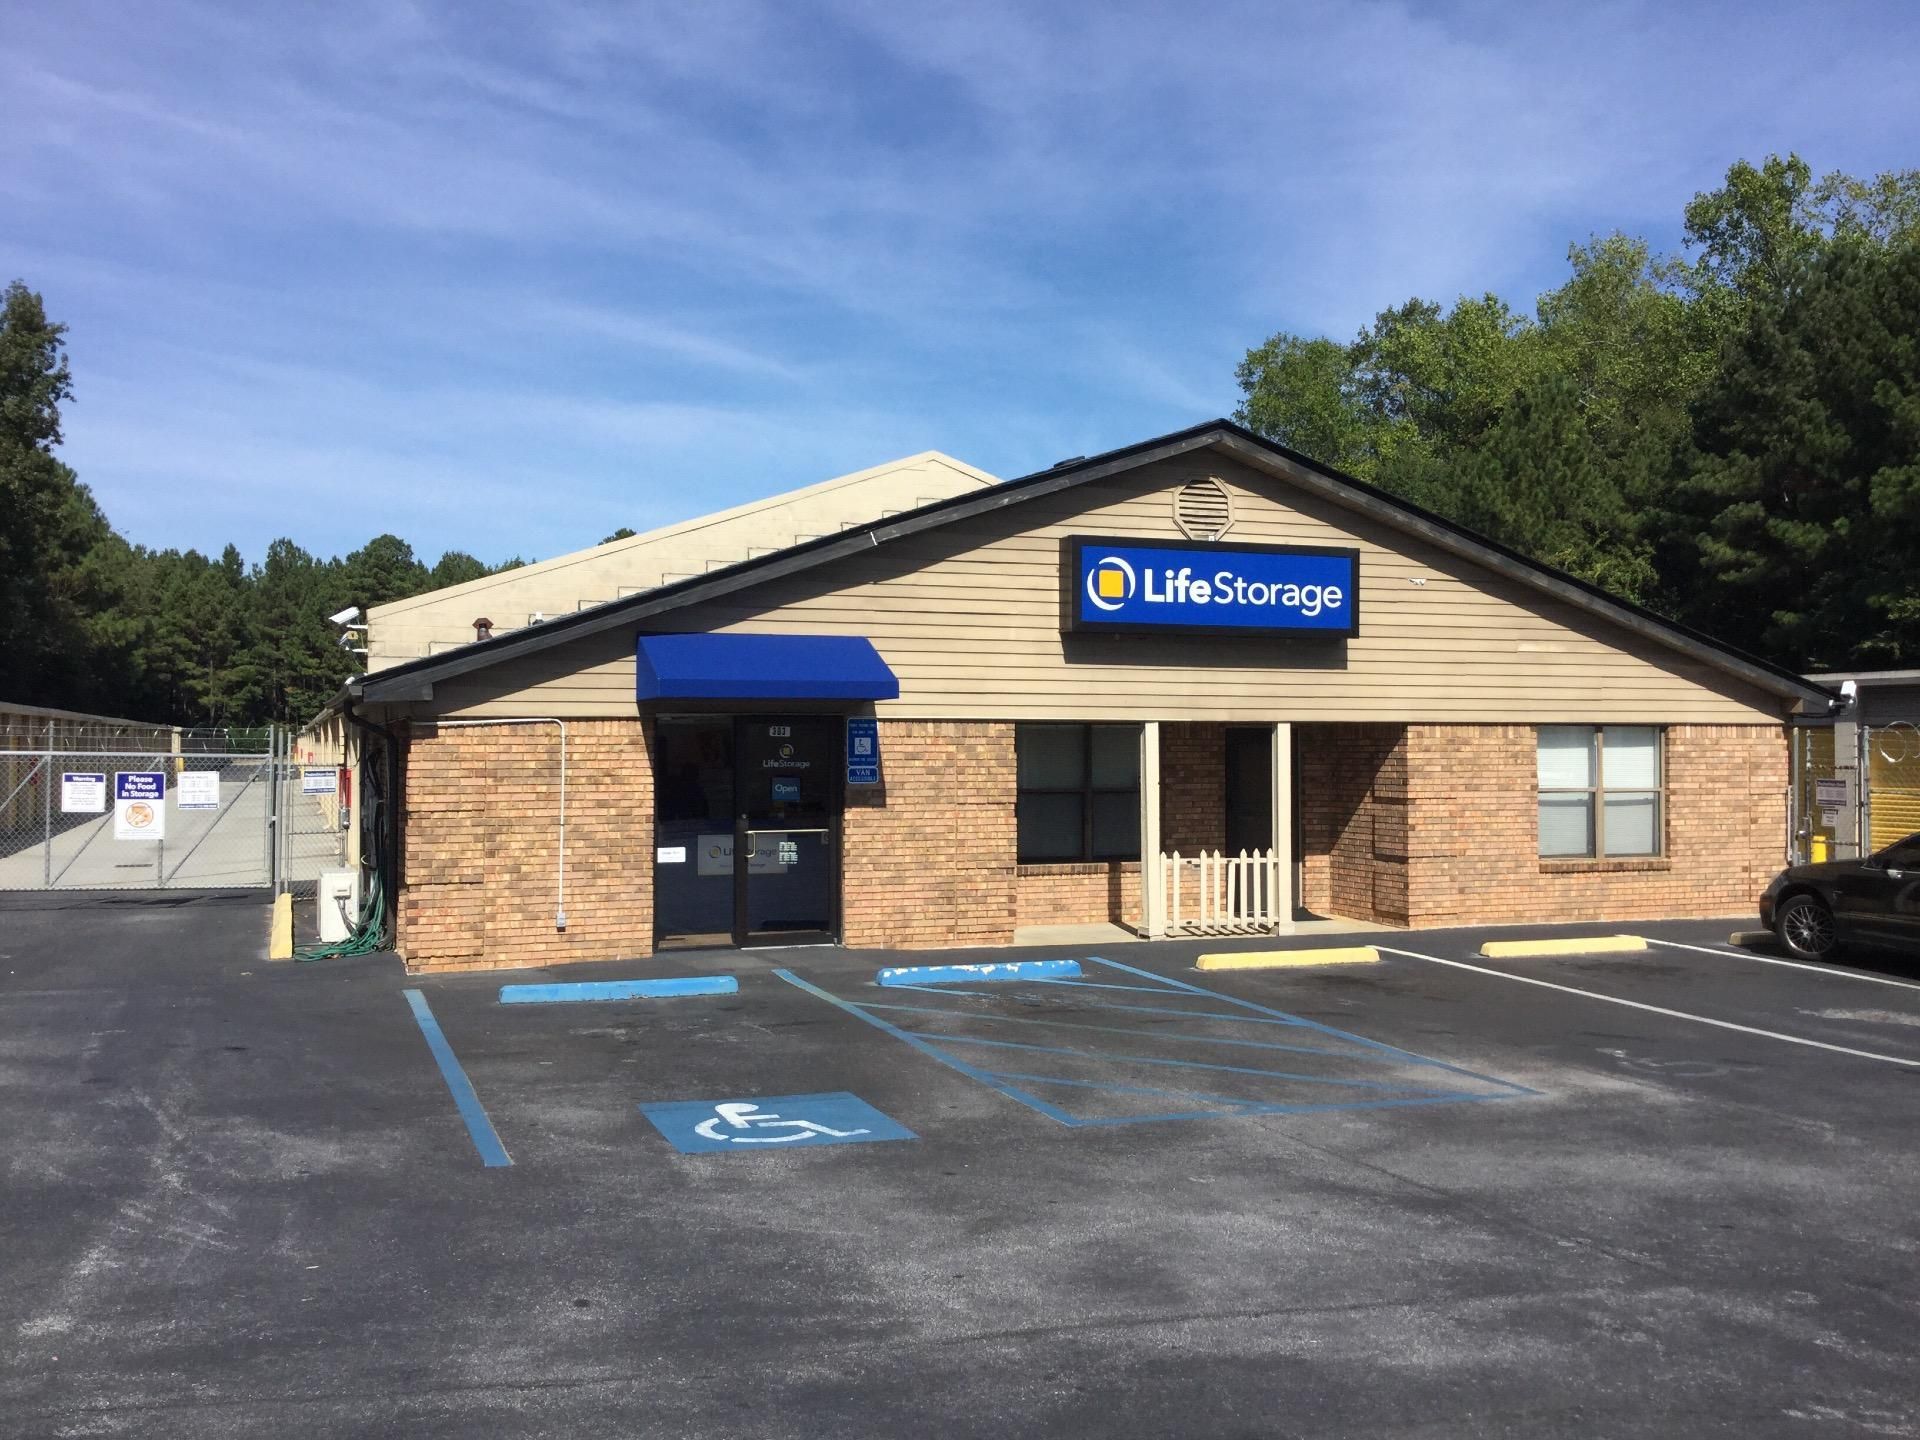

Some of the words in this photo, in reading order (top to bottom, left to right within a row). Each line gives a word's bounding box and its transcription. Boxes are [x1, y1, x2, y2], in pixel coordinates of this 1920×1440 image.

[128, 775, 153, 783] Please
[774, 783, 798, 794] Open
[130, 790, 159, 798] Storage
